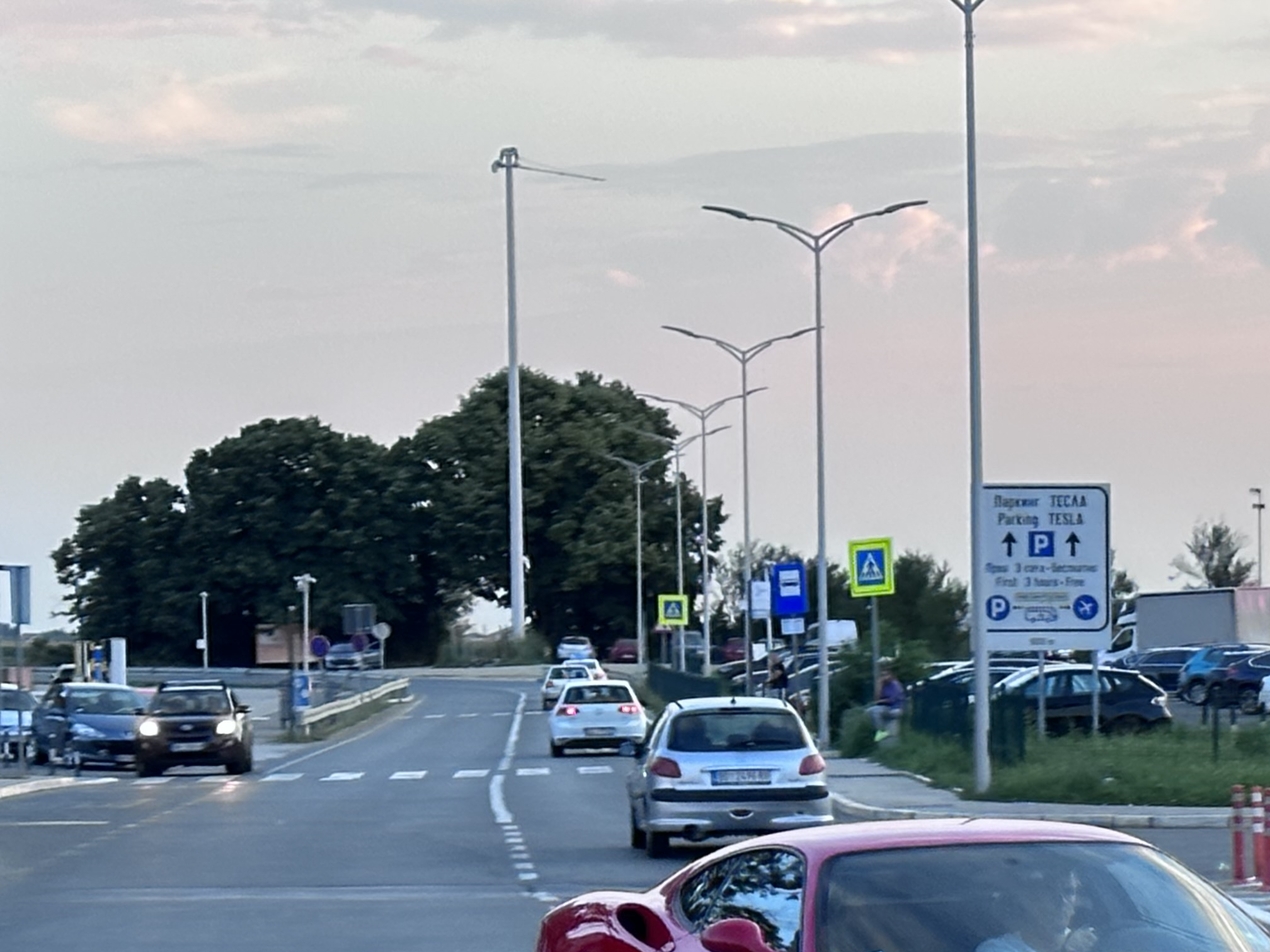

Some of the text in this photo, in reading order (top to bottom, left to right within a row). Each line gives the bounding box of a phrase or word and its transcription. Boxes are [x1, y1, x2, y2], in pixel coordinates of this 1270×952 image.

[998, 512, 1084, 529] Parking TESLA
[995, 576, 1018, 587] First
